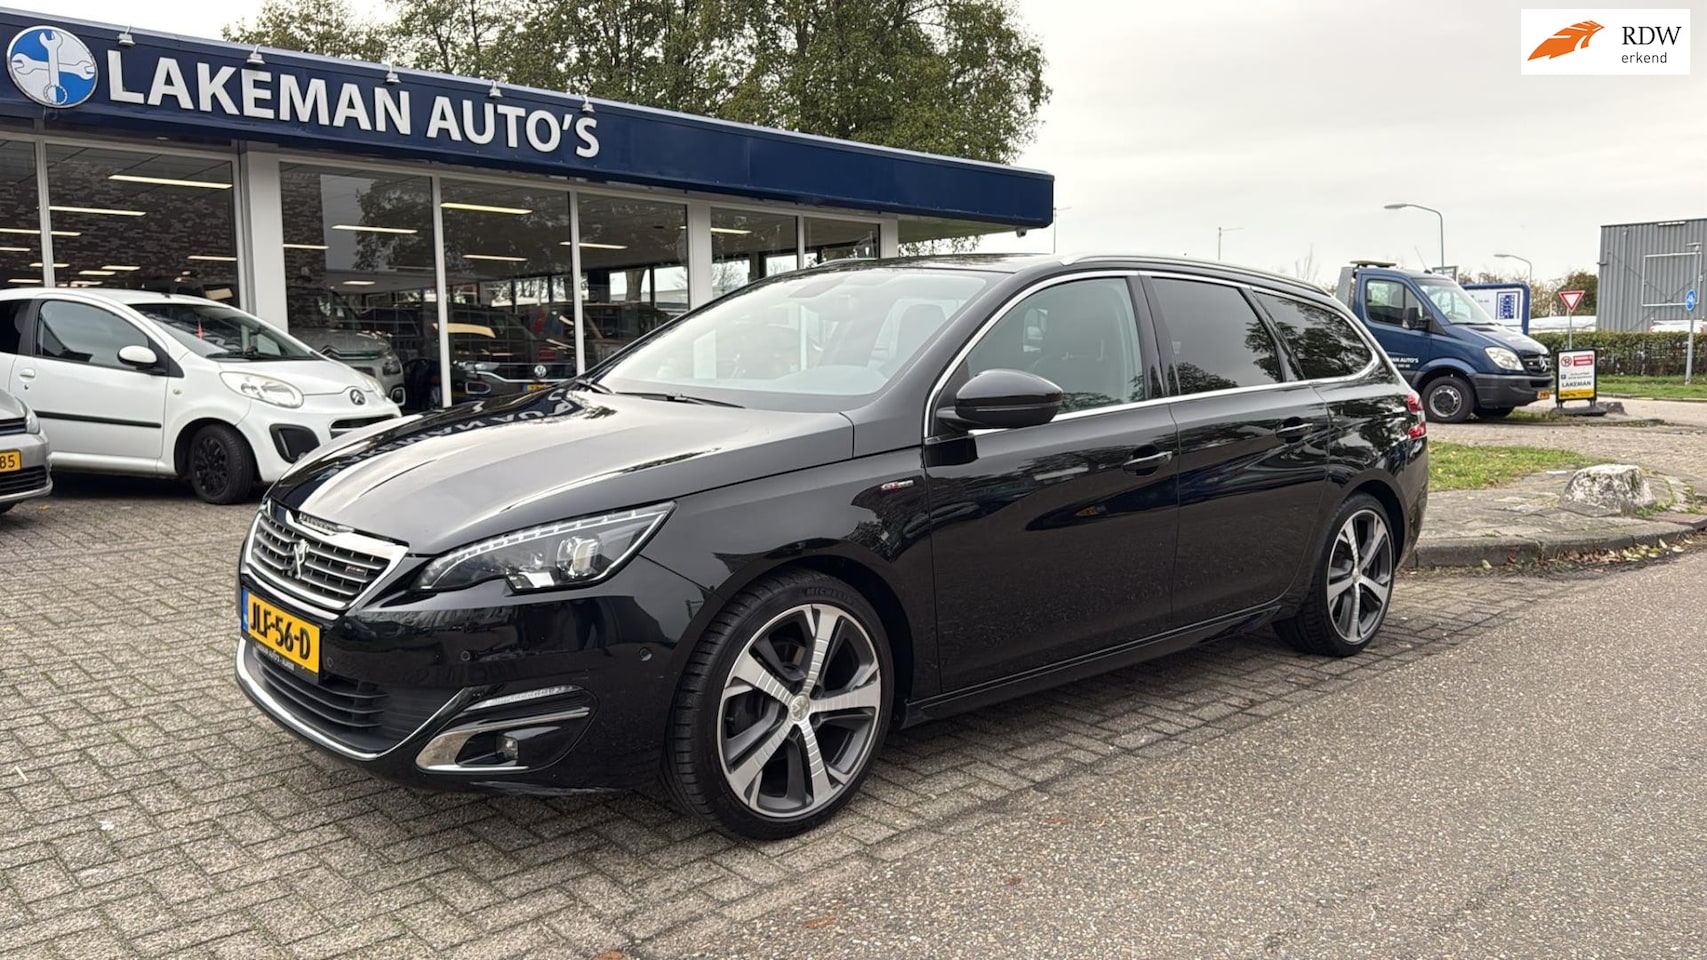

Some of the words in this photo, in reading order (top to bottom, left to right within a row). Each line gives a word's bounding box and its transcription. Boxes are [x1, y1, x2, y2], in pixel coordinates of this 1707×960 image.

[107, 50, 411, 135] LAKEMAN
[426, 96, 600, 158] AUTO'S
[250, 602, 311, 660] JLF-56-D
